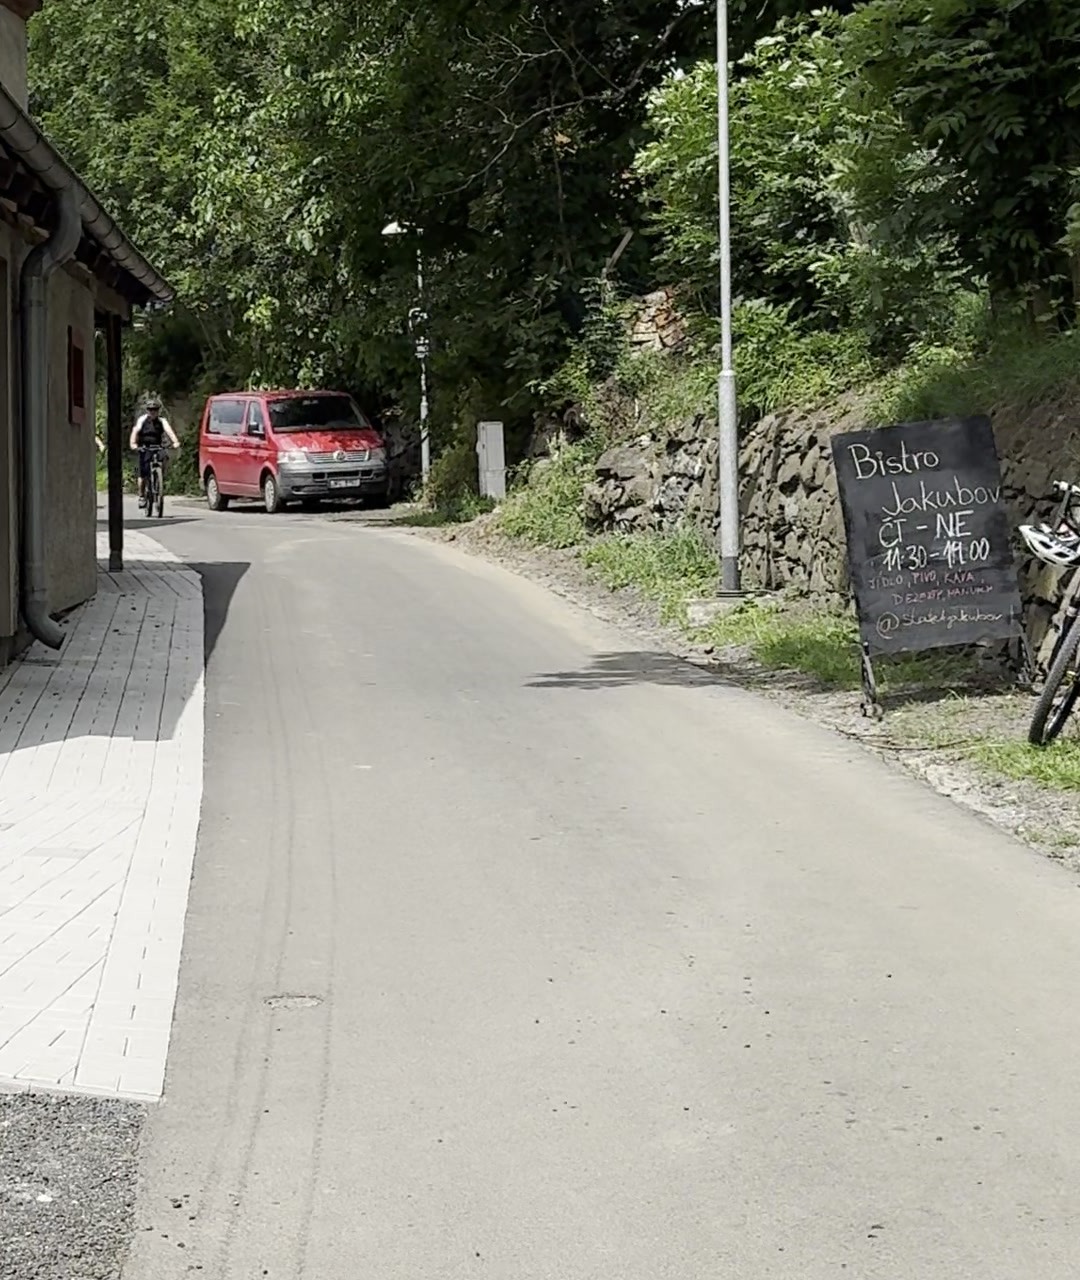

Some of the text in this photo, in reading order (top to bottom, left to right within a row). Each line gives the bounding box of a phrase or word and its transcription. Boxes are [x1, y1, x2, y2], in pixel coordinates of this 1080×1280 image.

[847, 440, 940, 481] Bistro
[881, 475, 1001, 517] Jakubov
[878, 516, 908, 548] ČT
[936, 509, 975, 538] NE
